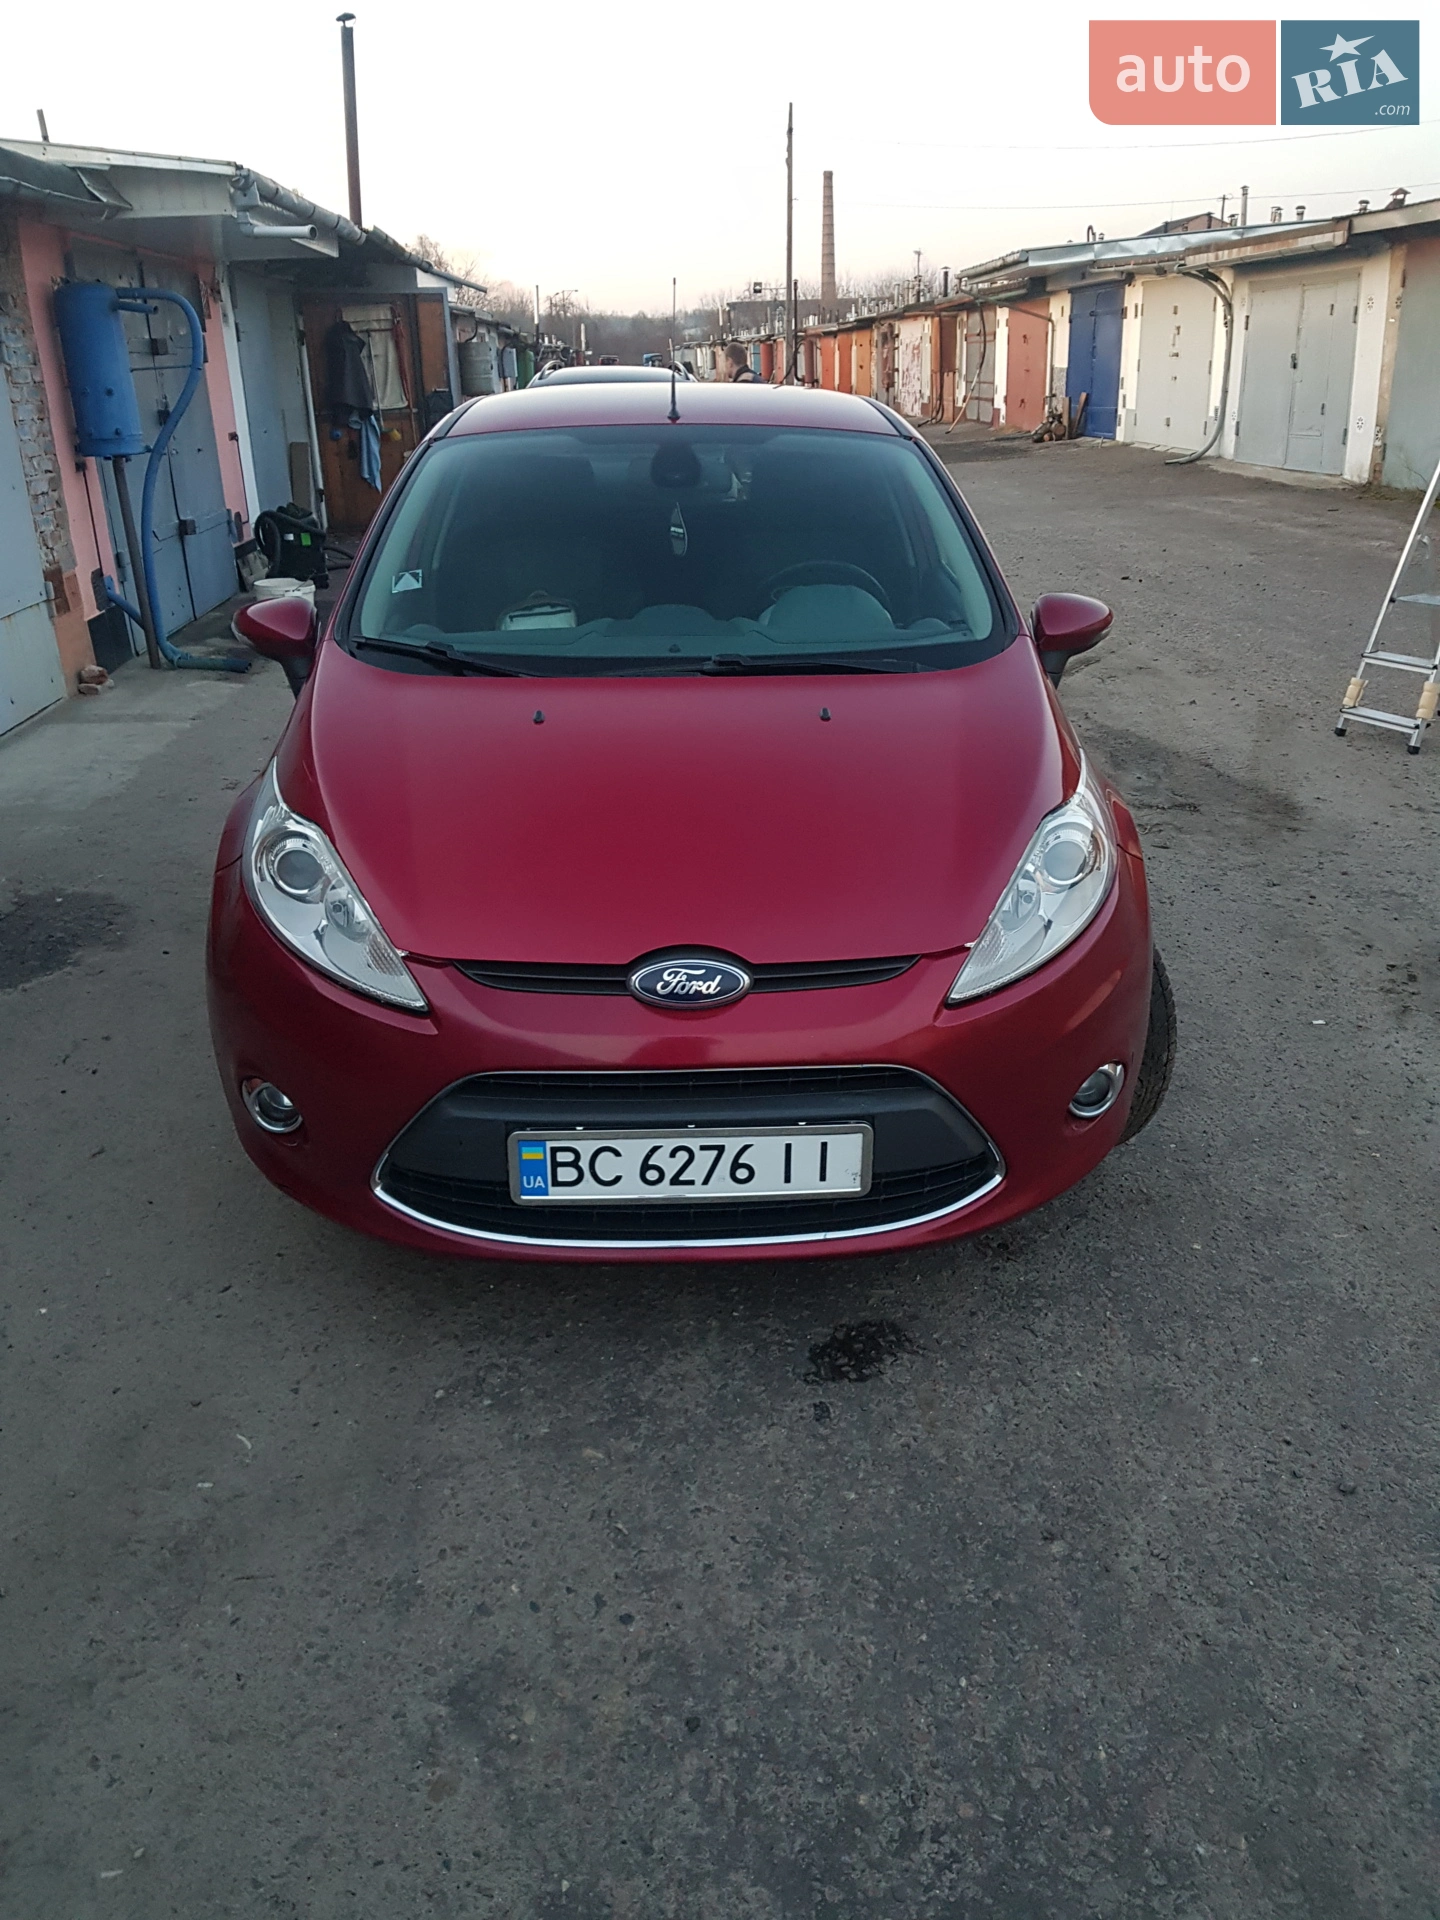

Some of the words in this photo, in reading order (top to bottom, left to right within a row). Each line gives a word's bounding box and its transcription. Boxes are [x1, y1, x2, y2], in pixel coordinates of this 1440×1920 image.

[656, 968, 722, 995] Ford
[550, 1145, 623, 1187] BC
[639, 1144, 756, 1186] 6276
[523, 1176, 545, 1189] UA
